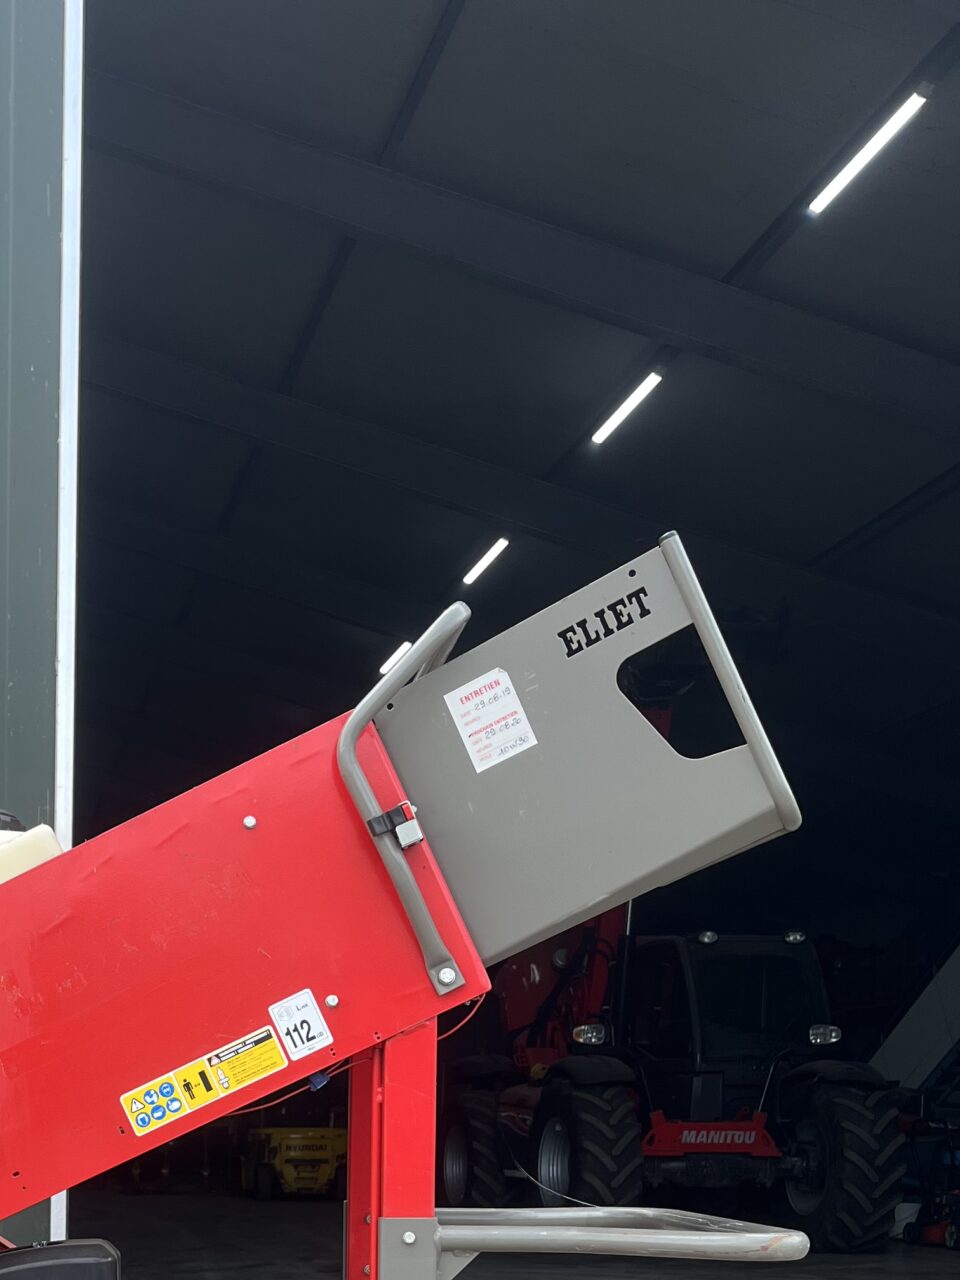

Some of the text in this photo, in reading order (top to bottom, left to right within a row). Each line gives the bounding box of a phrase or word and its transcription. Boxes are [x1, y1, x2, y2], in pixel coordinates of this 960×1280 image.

[557, 586, 651, 658] ELIET
[459, 679, 501, 705] ENTRETIEN
[285, 1019, 316, 1049] 112
[285, 1143, 328, 1152] HYUNDAI
[681, 1130, 757, 1144] MANITOU
